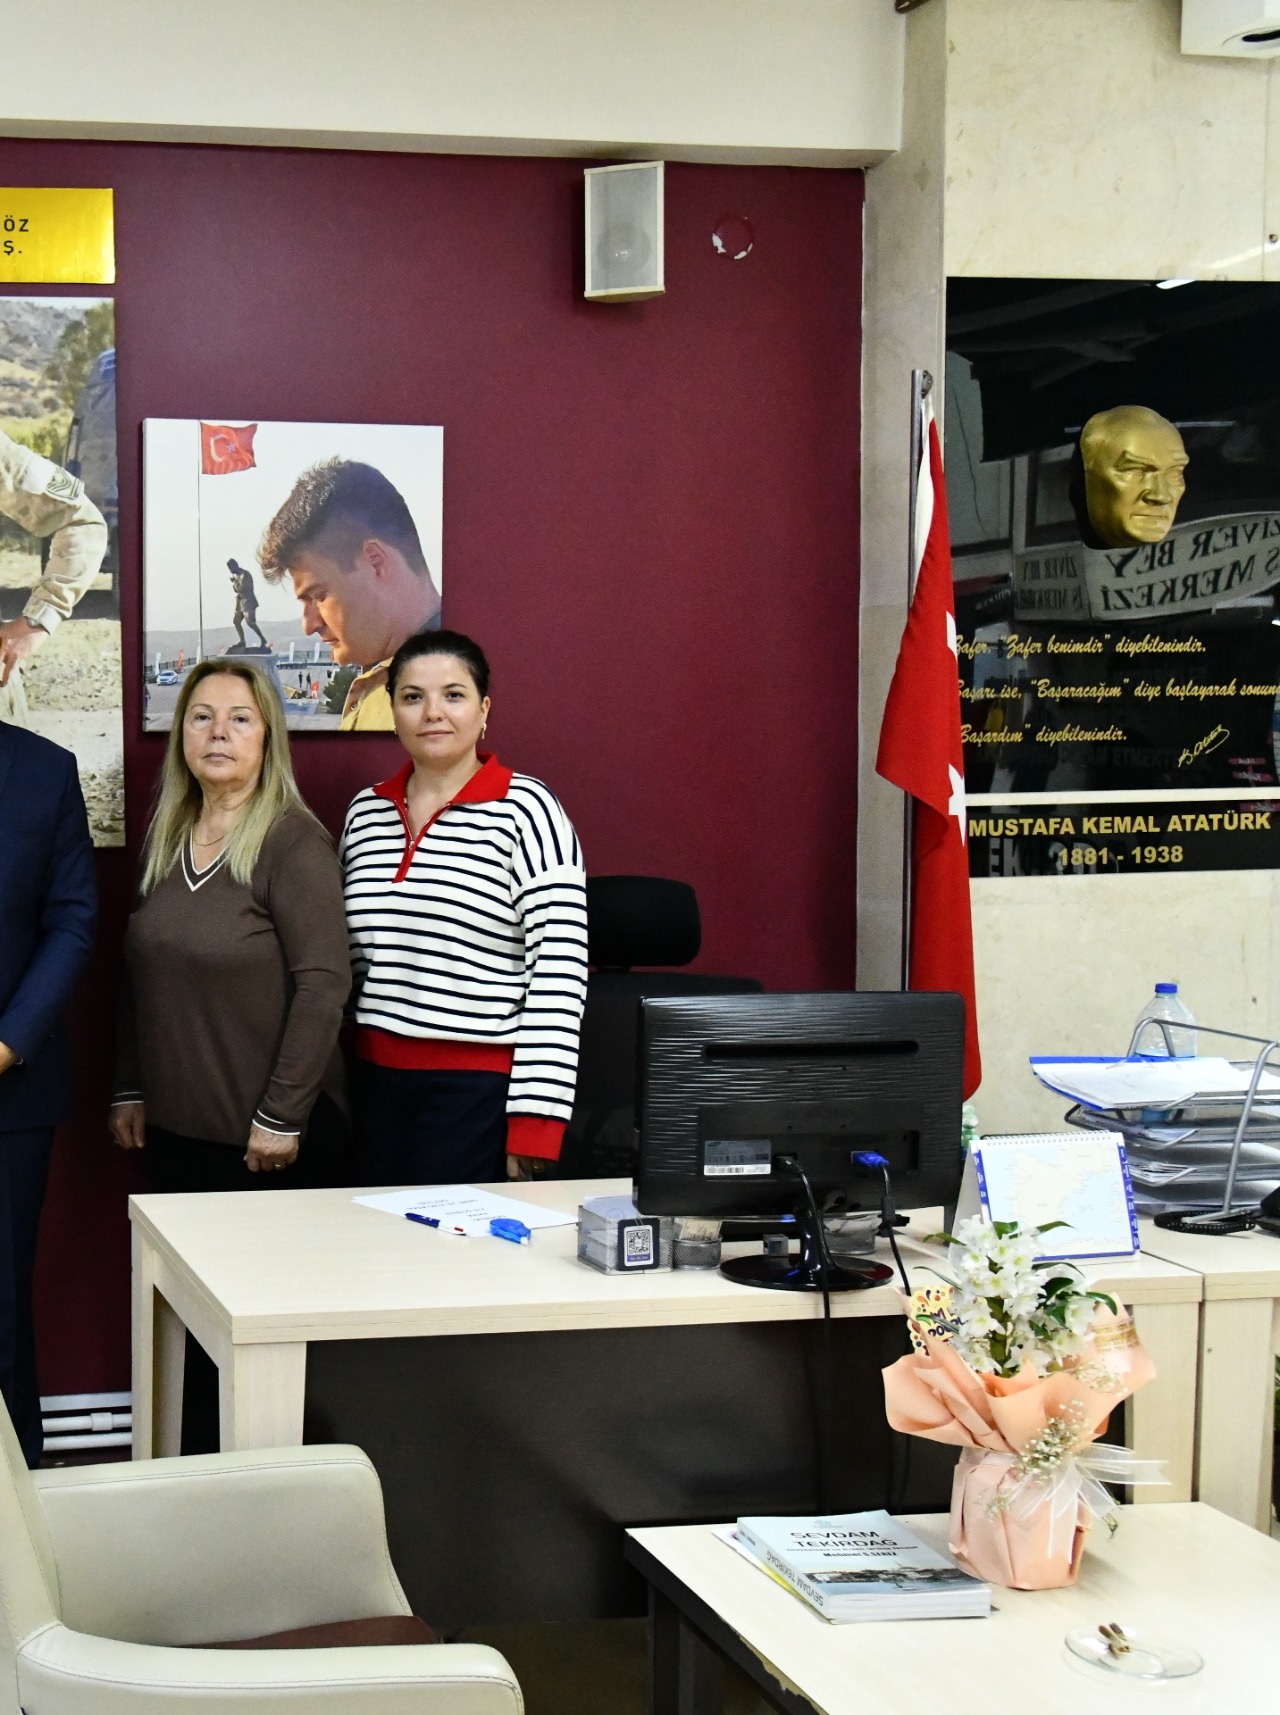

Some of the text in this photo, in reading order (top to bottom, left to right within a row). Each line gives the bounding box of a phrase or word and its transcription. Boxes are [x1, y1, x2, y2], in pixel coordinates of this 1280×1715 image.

[1133, 680, 1162, 702] diye
[1165, 677, 1238, 702] başlayarak
[969, 809, 1272, 837] MUSTAFA KEMAL ATATÜRK
[1058, 847, 1110, 866] 1881
[1131, 845, 1184, 864] 1938
[790, 1531, 880, 1539] SEVDAM
[792, 1537, 898, 1548] TEKİRDAĞ
[796, 1575, 825, 1607] SEVDAM
